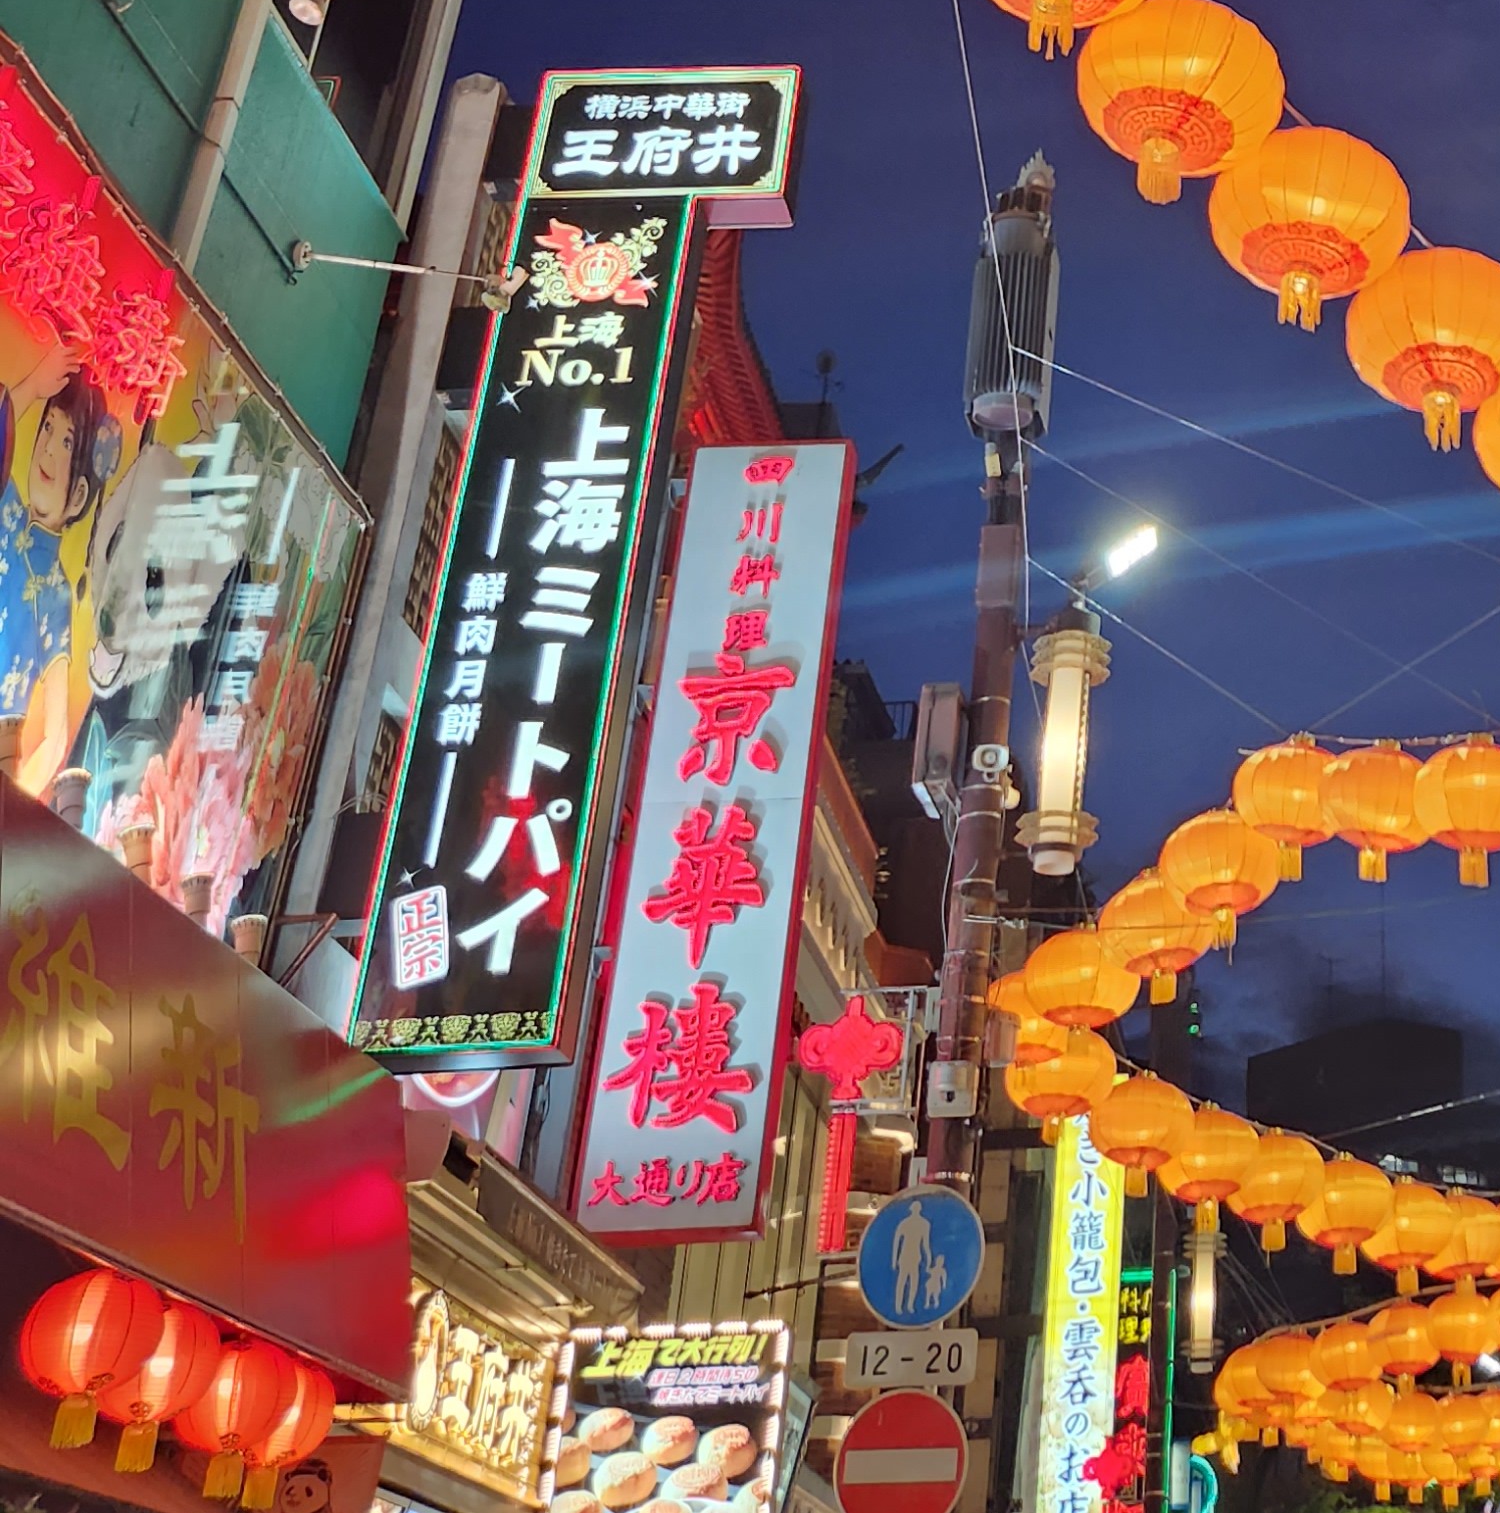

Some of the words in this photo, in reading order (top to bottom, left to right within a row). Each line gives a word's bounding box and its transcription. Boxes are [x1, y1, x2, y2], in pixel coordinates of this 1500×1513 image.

[584, 92, 750, 121] 横浜中華街
[552, 124, 762, 177] 王府井
[533, 311, 625, 347] 上海
[513, 347, 635, 387] No.1
[727, 456, 795, 651] 四川料理
[436, 572, 508, 746] 鮮肉月餅
[454, 408, 631, 976] 上海ミートパイ
[402, 891, 443, 979] 正宗
[587, 1153, 748, 1207] 大通り店
